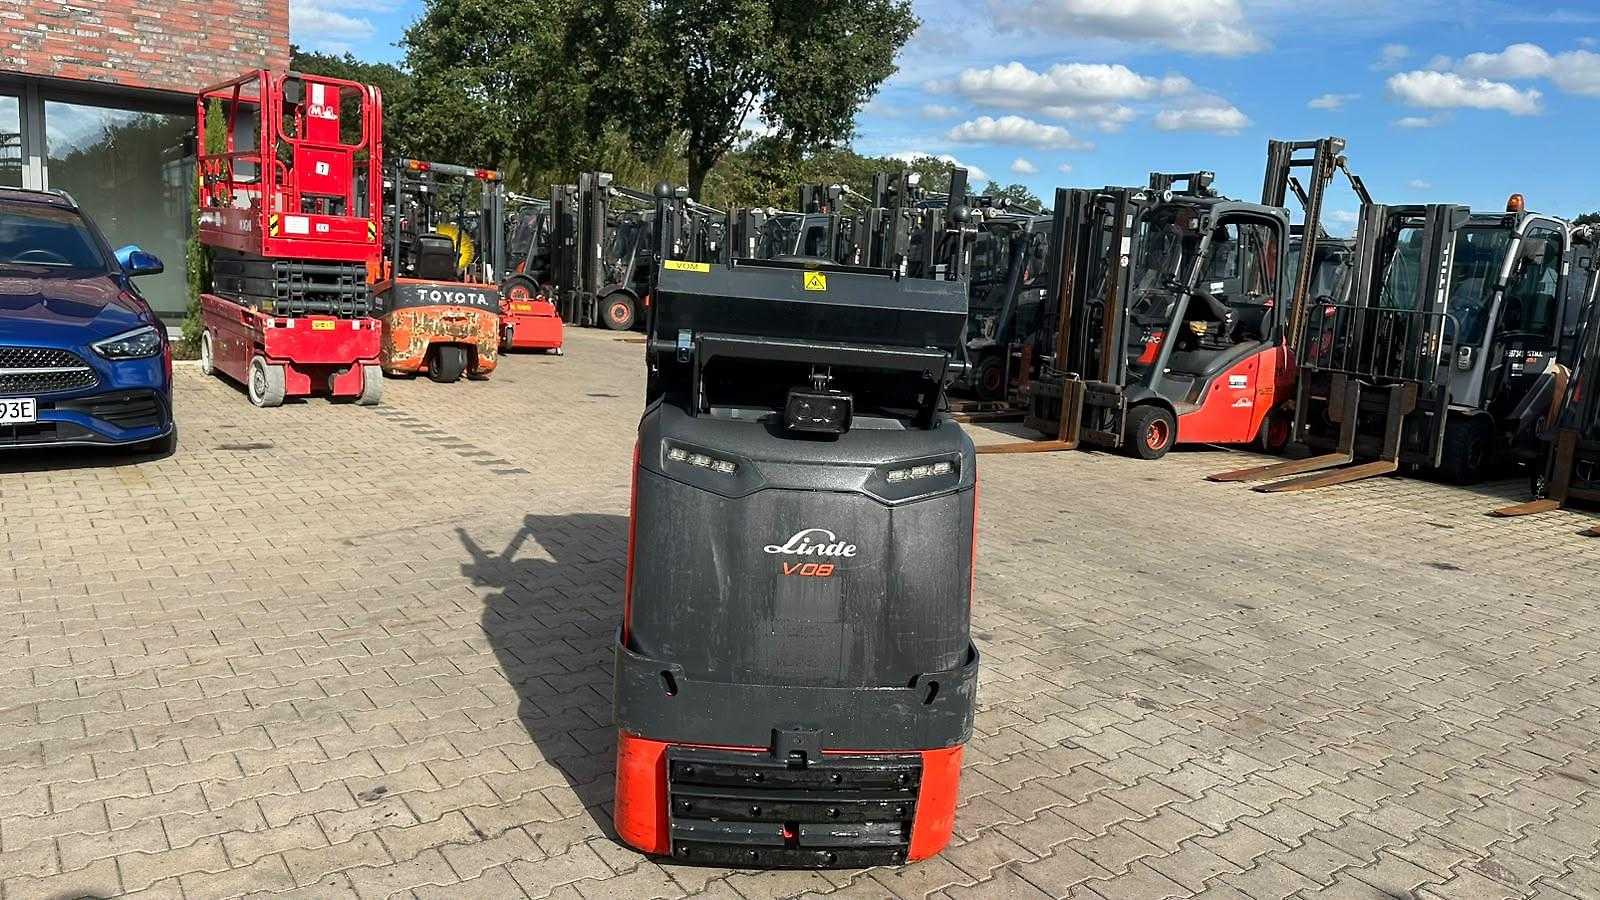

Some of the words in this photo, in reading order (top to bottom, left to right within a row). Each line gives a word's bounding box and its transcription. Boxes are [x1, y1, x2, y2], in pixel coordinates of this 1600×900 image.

[417, 288, 489, 306] TOYOTA
[763, 528, 857, 557] Linde
[783, 561, 834, 577] V08
